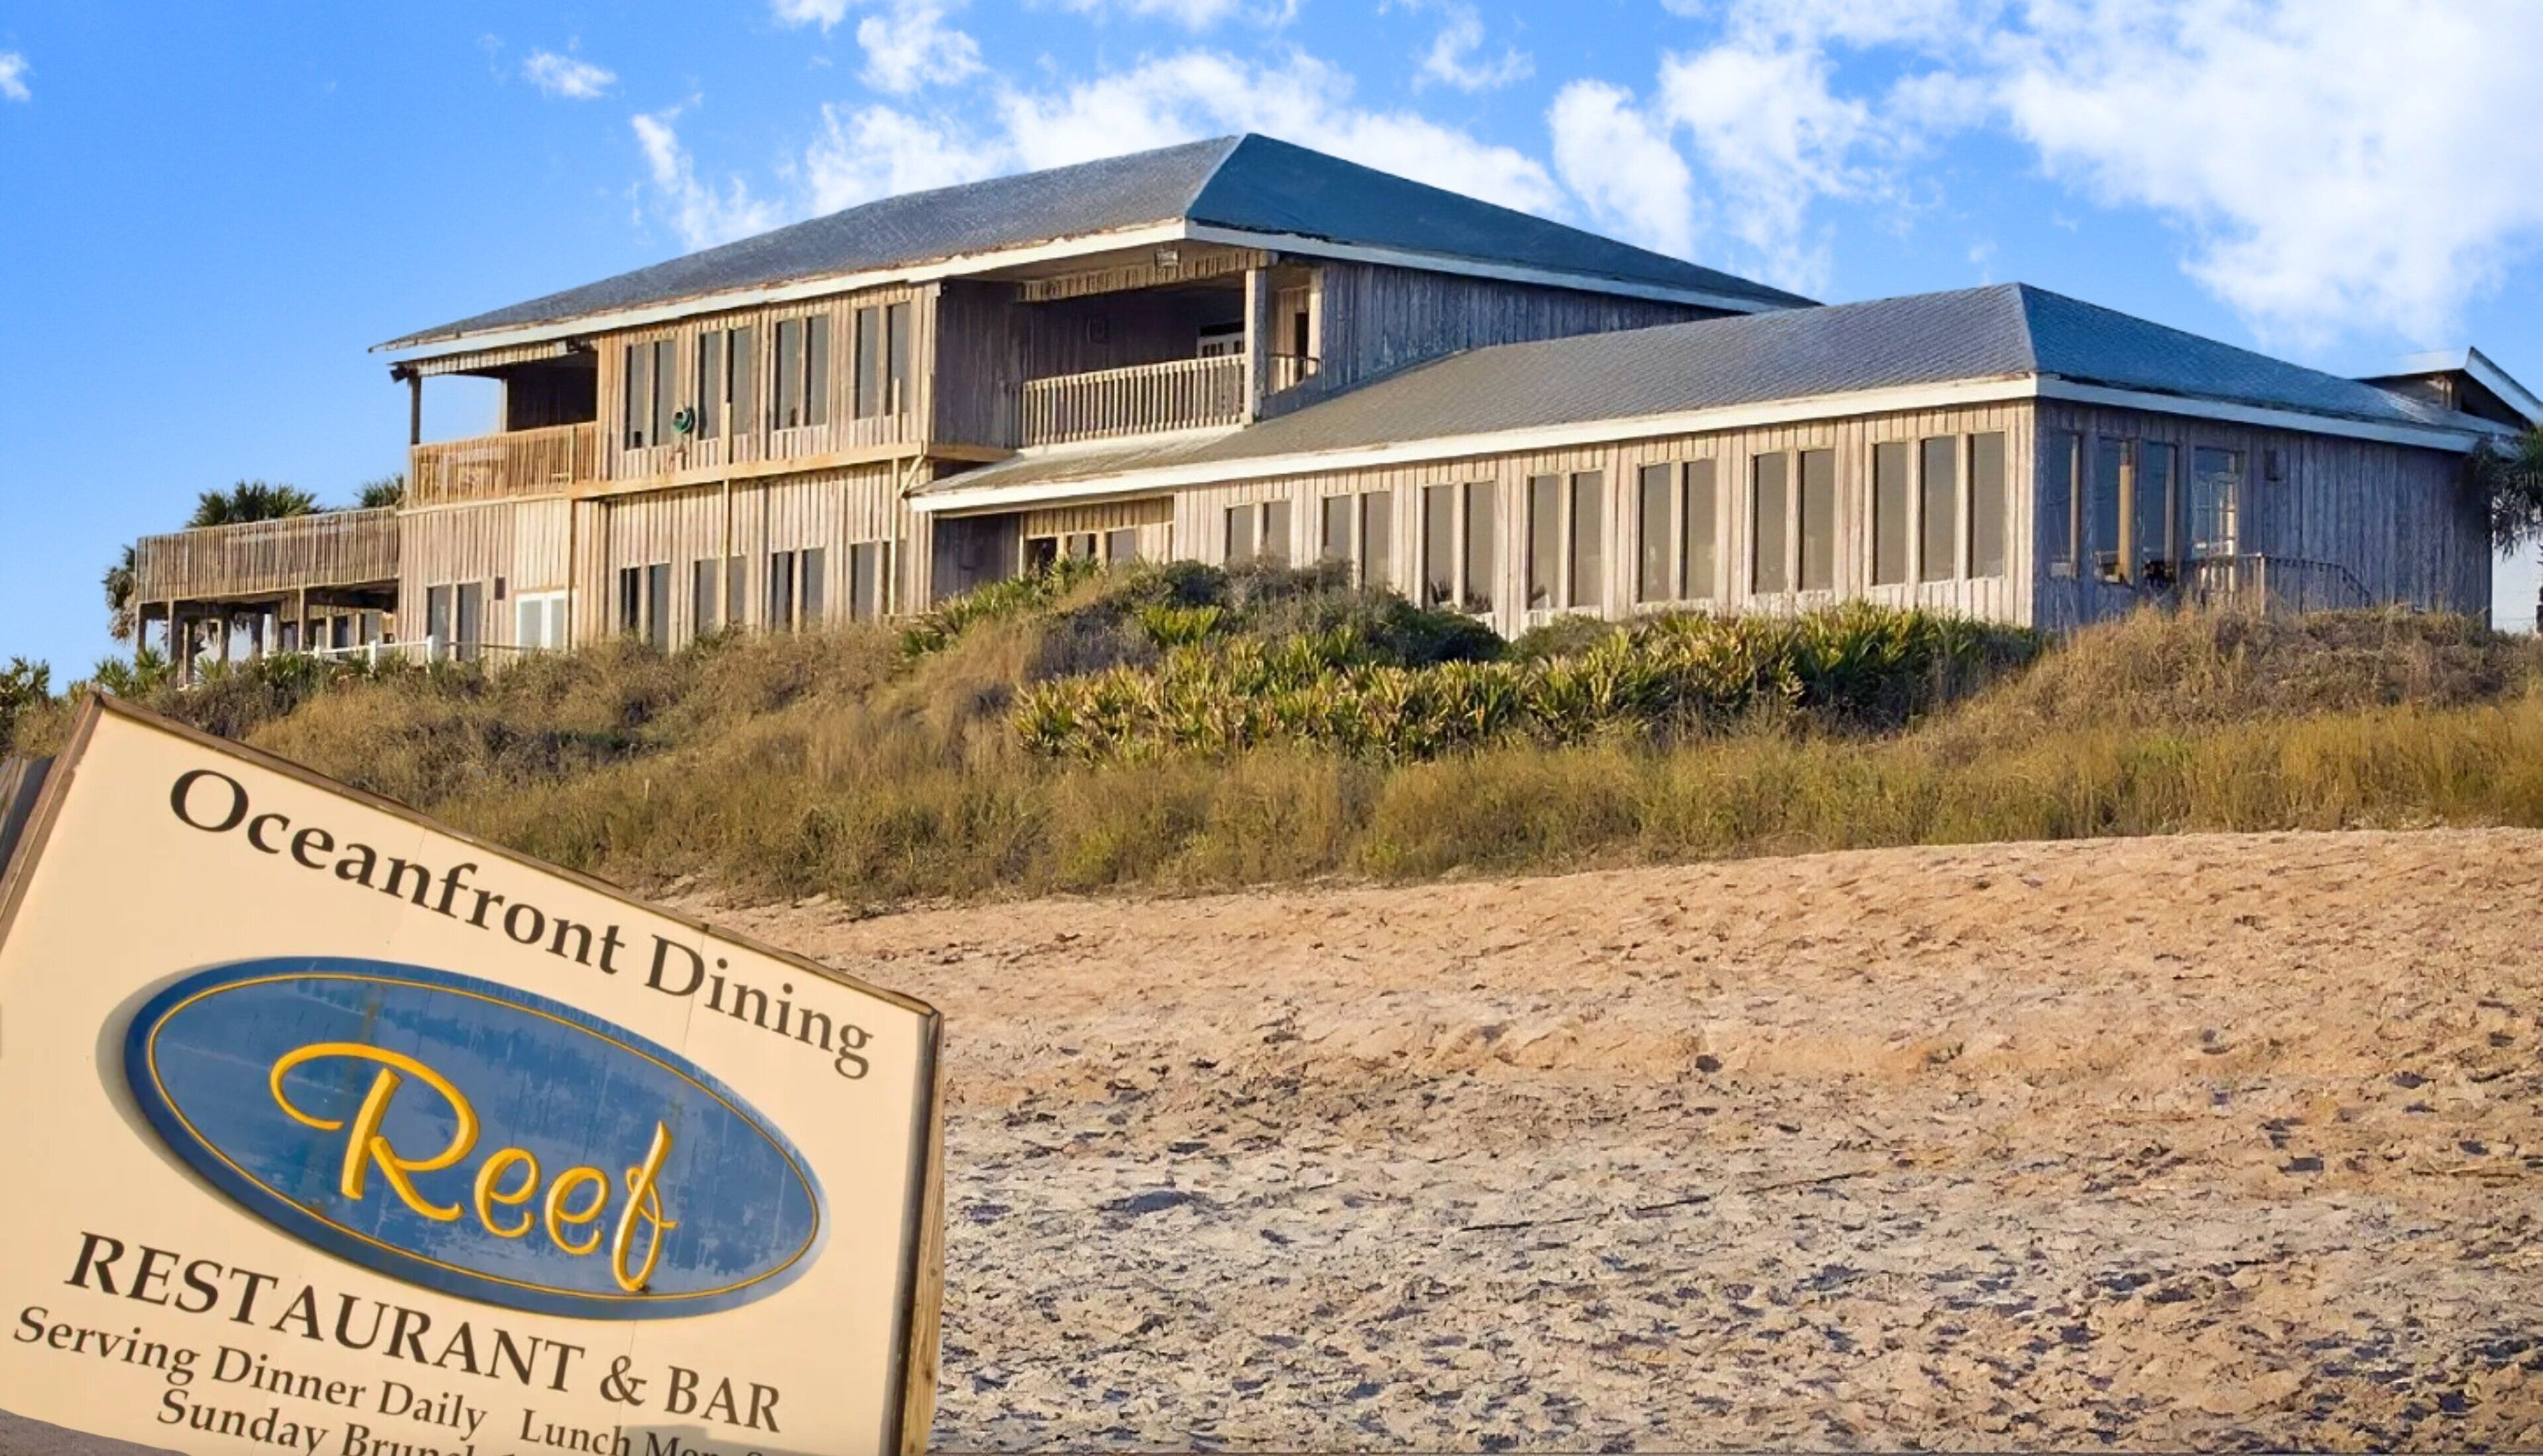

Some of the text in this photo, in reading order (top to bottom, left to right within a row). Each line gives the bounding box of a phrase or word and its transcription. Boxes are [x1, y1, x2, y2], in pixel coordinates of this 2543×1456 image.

[170, 768, 874, 1080] Oceanfront Dining
[270, 1042, 679, 1292] Reef
[13, 1306, 201, 1386] Serving
[211, 1345, 367, 1410] Dinner
[377, 1379, 489, 1442] Daily
[519, 1408, 632, 1456] Lunch
[64, 1231, 781, 1433] RESTAURANT & BAR
[156, 1388, 476, 1456] Sunday Bru
